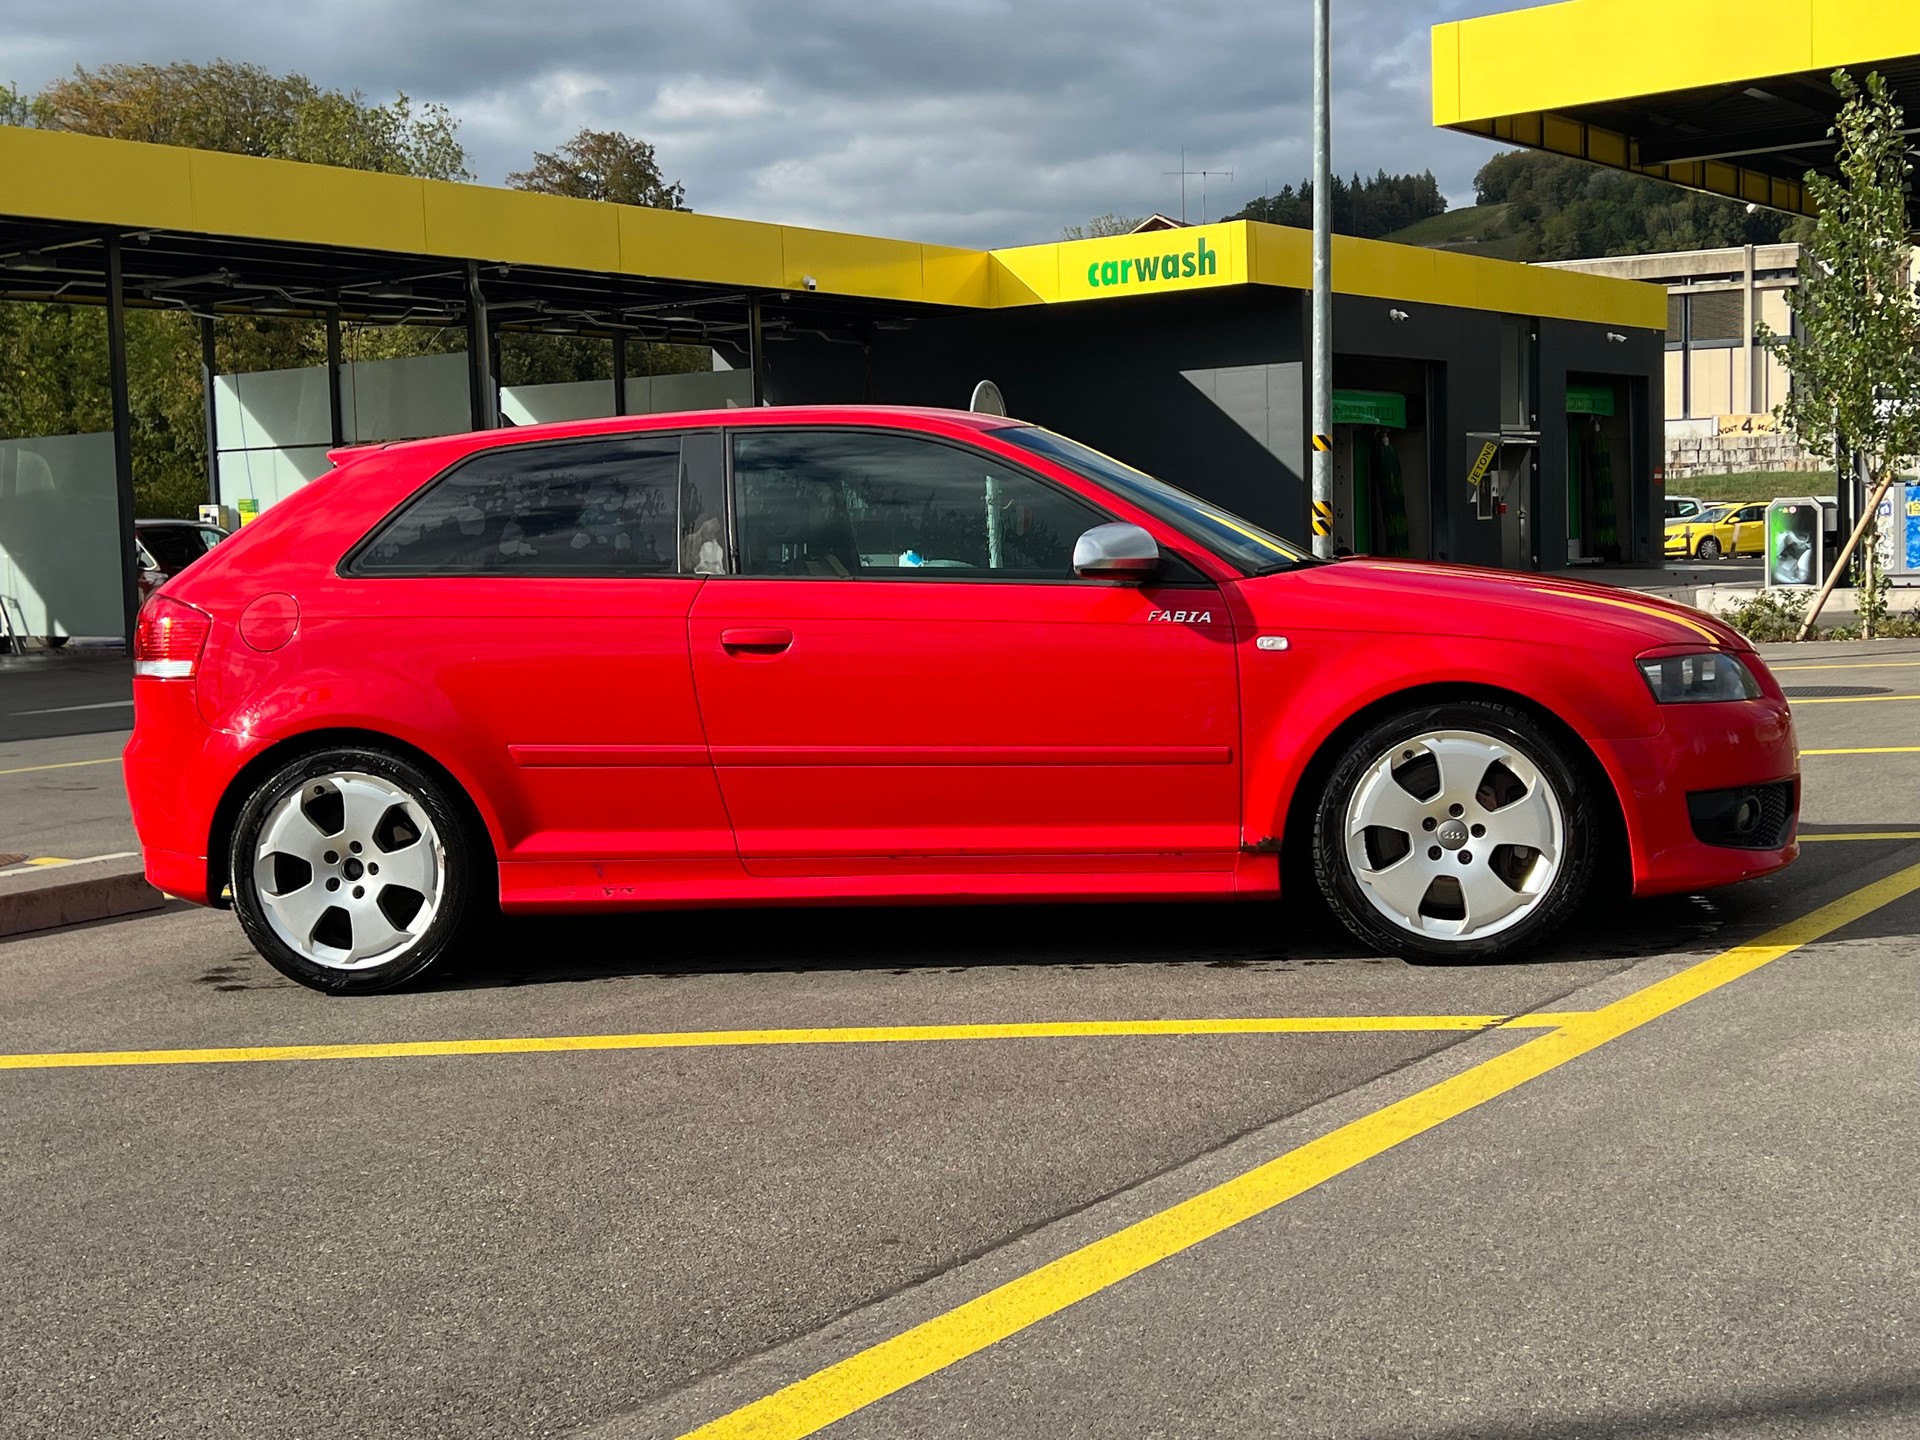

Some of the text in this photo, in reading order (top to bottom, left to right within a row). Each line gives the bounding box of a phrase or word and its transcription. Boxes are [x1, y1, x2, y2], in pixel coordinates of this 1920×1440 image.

[1088, 237, 1216, 287] carwash
[1741, 417, 1753, 434] 4
[1470, 443, 1495, 484] JETONS
[1147, 610, 1212, 623] FABIA
